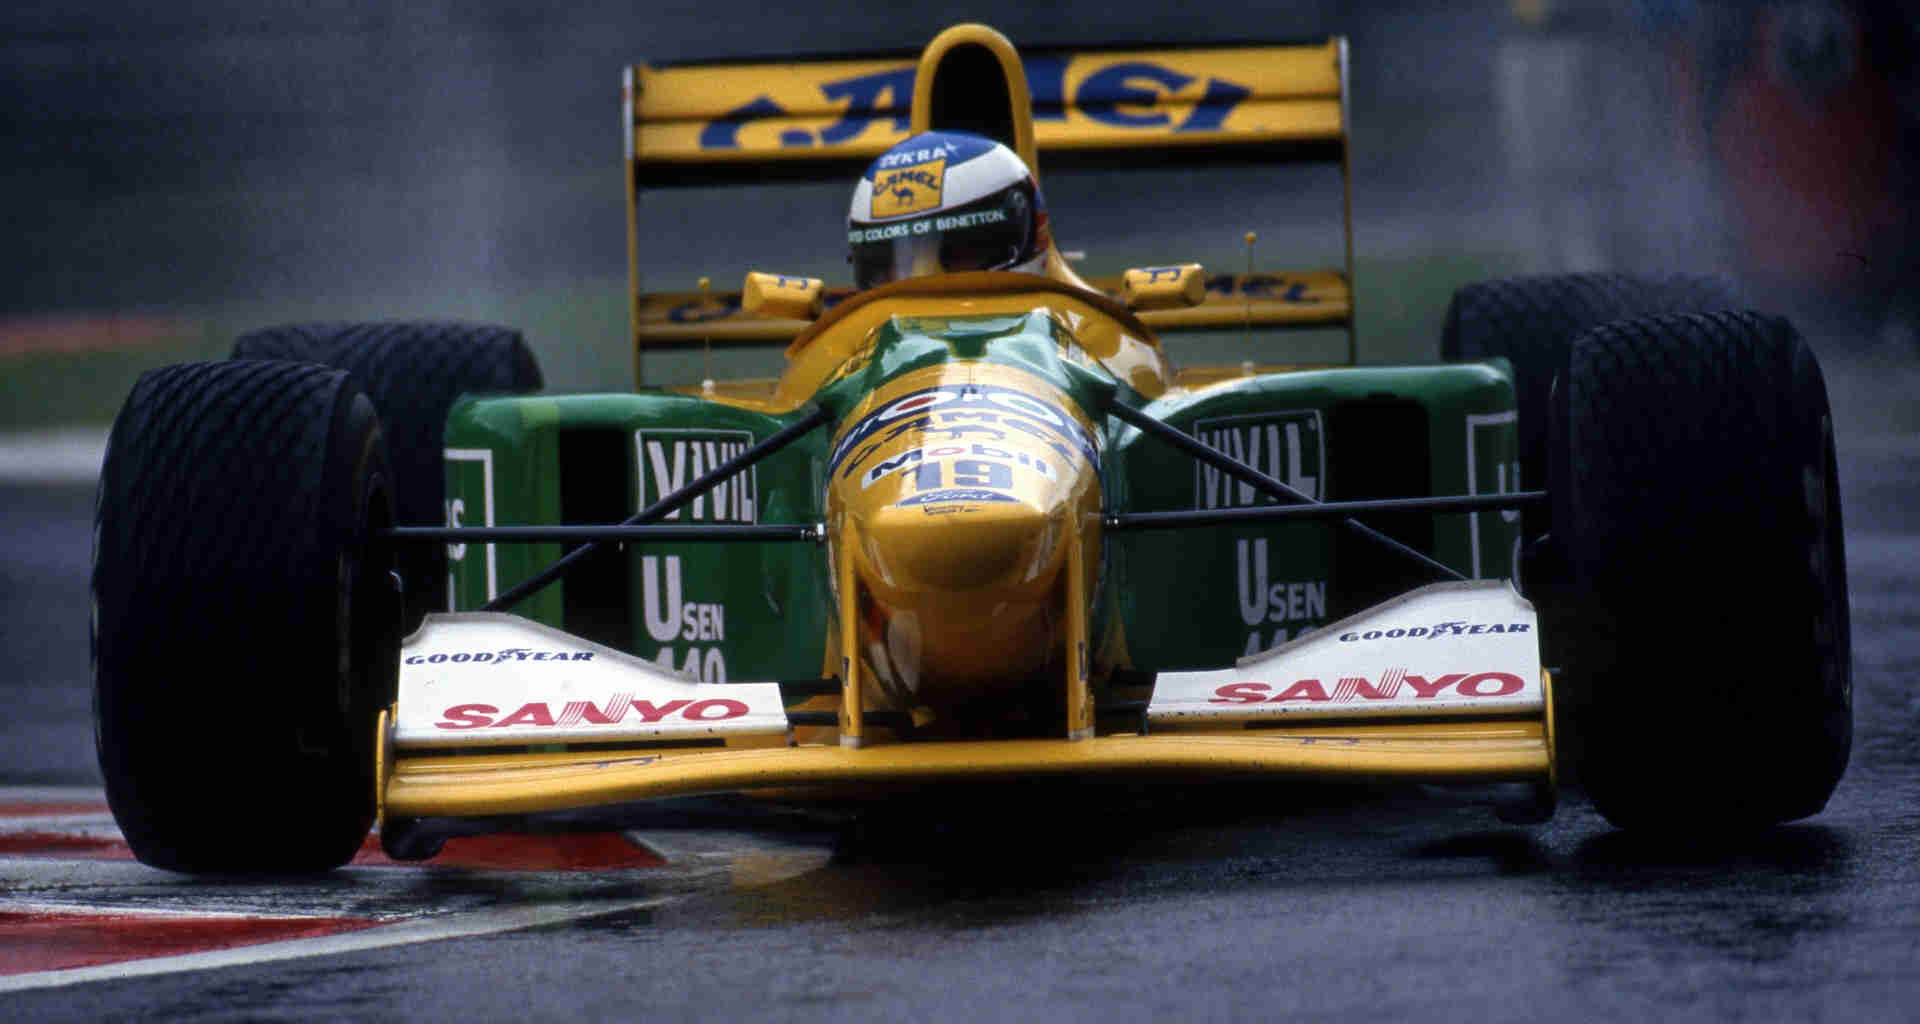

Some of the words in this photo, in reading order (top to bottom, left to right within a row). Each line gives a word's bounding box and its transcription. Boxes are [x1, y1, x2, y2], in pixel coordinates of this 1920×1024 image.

[872, 171, 940, 196] CAMEL
[865, 224, 909, 241] COLORS
[913, 220, 931, 235] OF
[936, 209, 1005, 231] BENETTON
[871, 443, 1048, 480] Mobil
[901, 459, 1013, 491] 19
[1200, 422, 1317, 508] VIVIL
[646, 440, 753, 521] VIVIL
[1338, 621, 1530, 643] GOODYEAR
[405, 647, 595, 666] GOODYEAR
[1208, 667, 1526, 704] SANYO
[434, 692, 750, 730] SANYO
